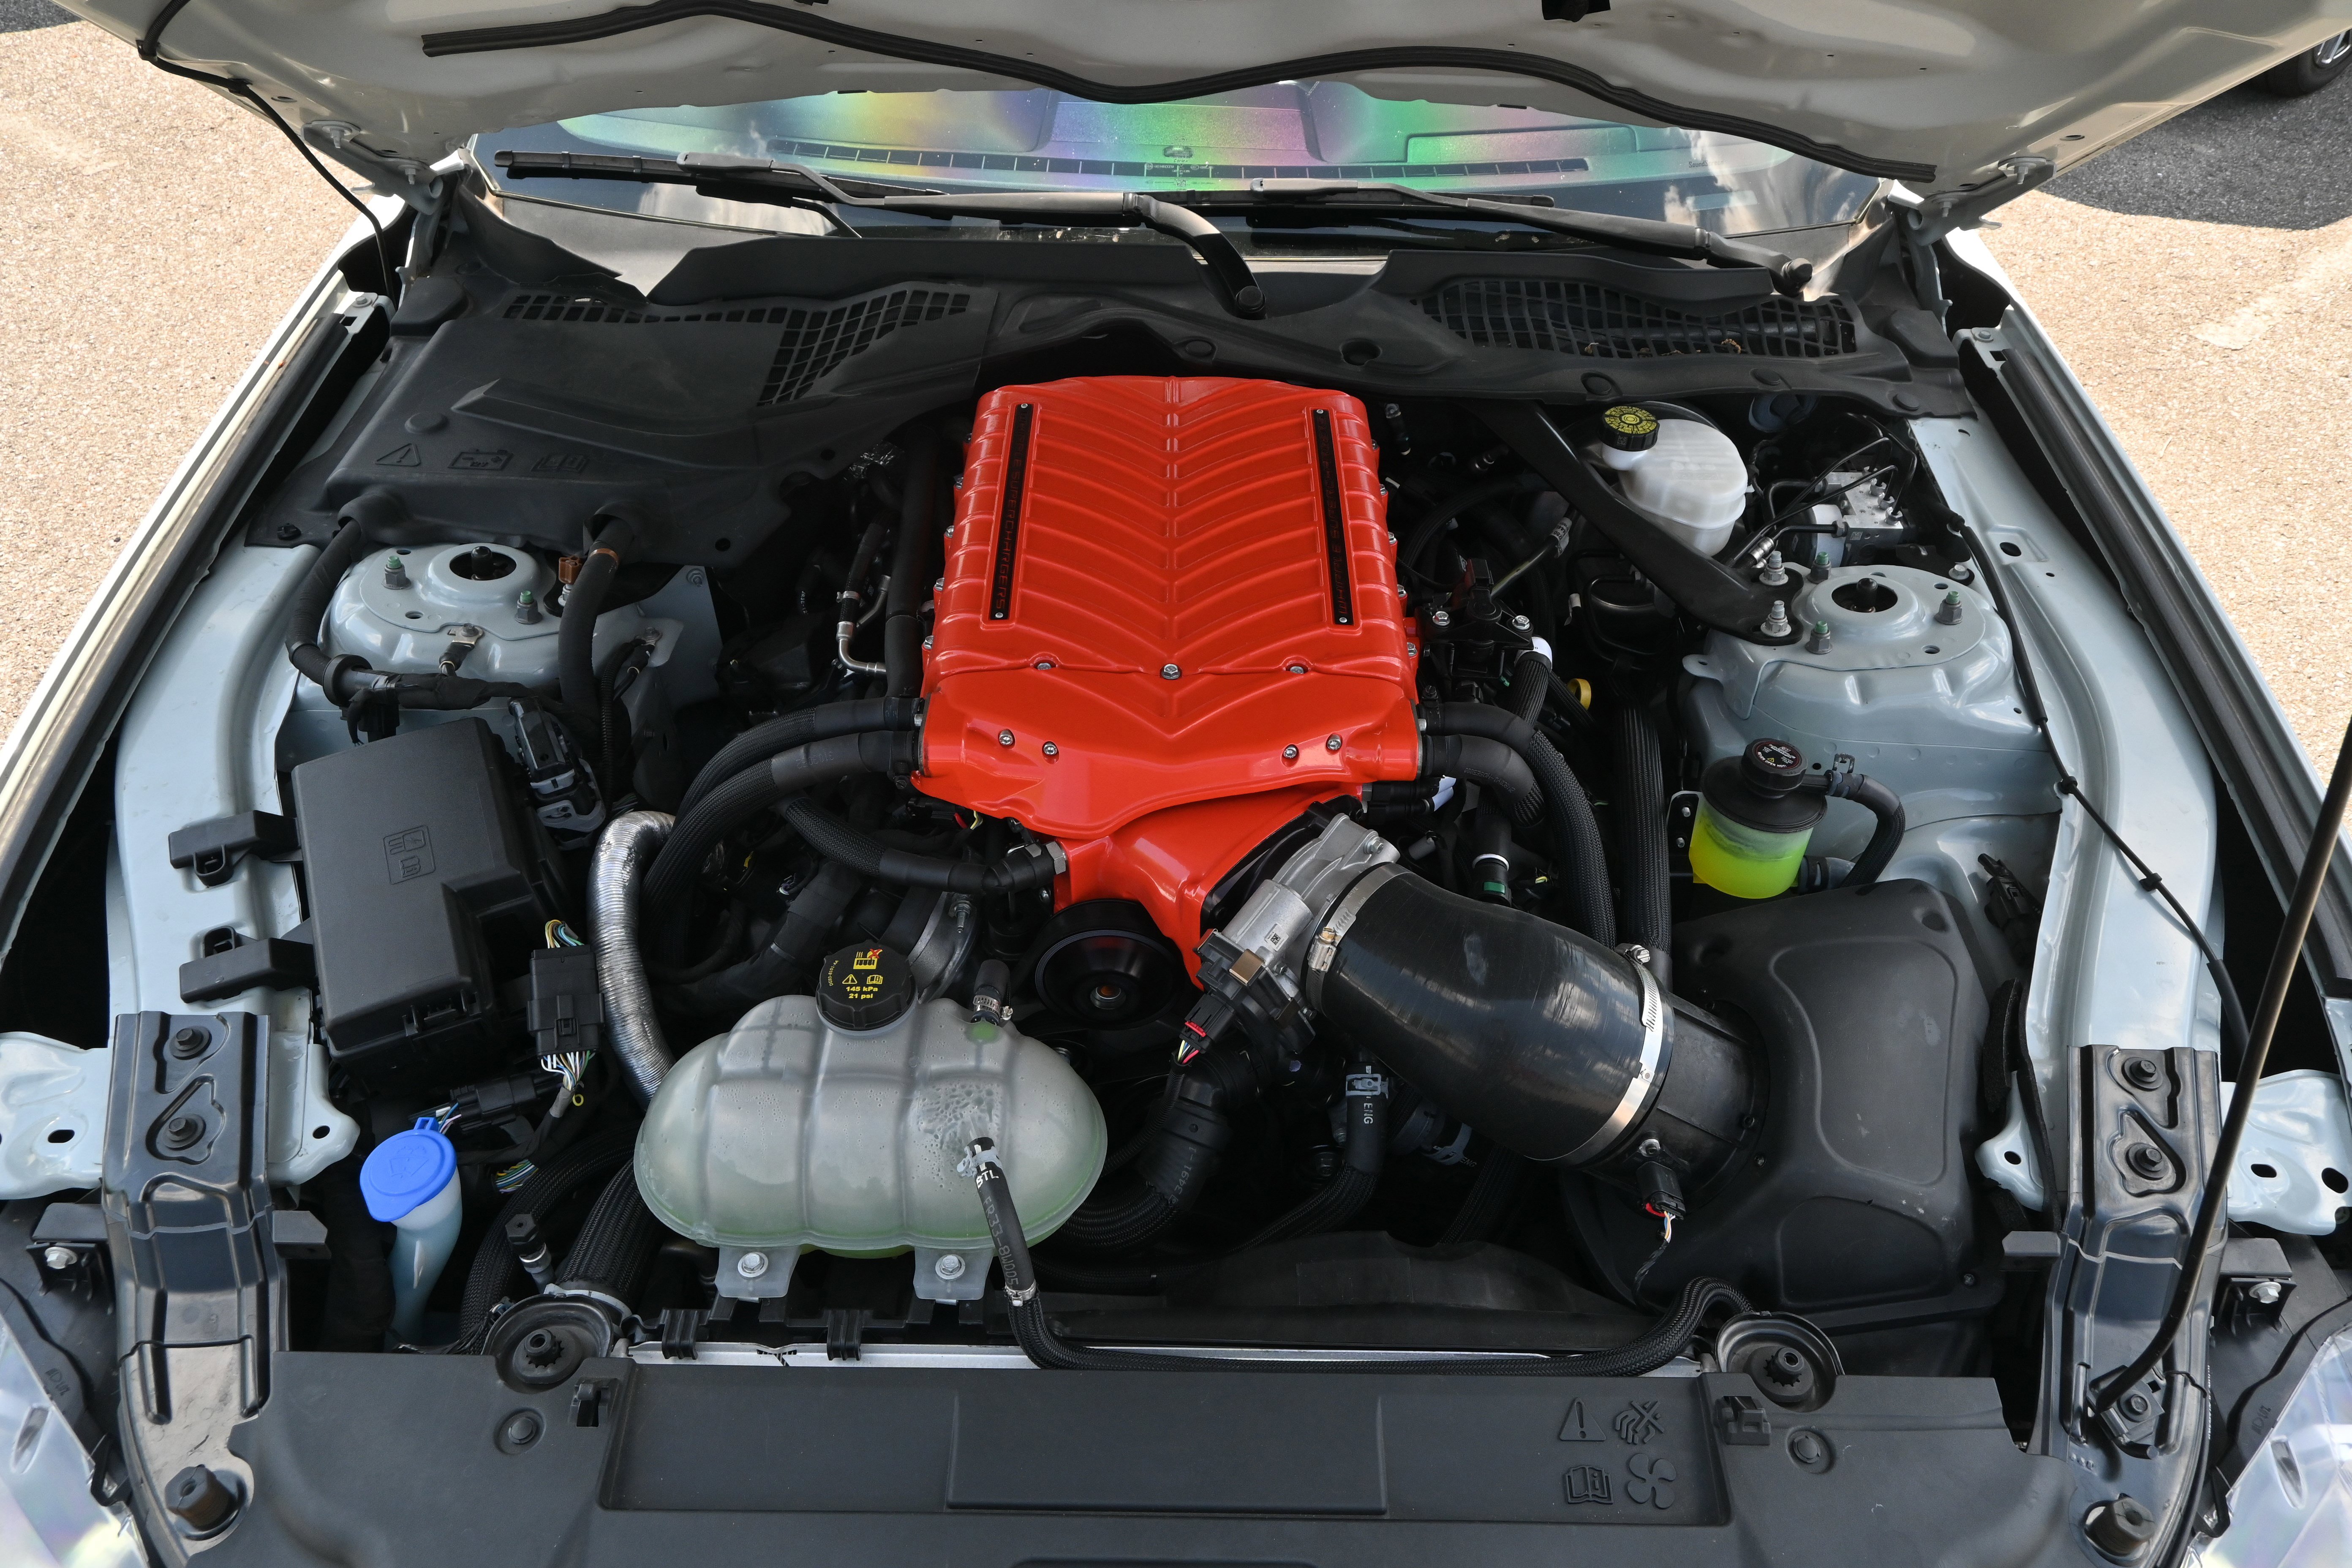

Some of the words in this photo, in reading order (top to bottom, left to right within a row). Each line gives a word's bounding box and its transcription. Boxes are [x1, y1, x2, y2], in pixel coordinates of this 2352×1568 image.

[1012, 411, 1028, 467] WHIPPLE
[1317, 415, 1339, 539] SUPERCHARGERS
[995, 469, 1022, 609] SUPERCHARGERS
[1331, 542, 1348, 615] WHIPPLE
[1364, 1102, 1373, 1124] ENG
[975, 1170, 999, 1189] BTL
